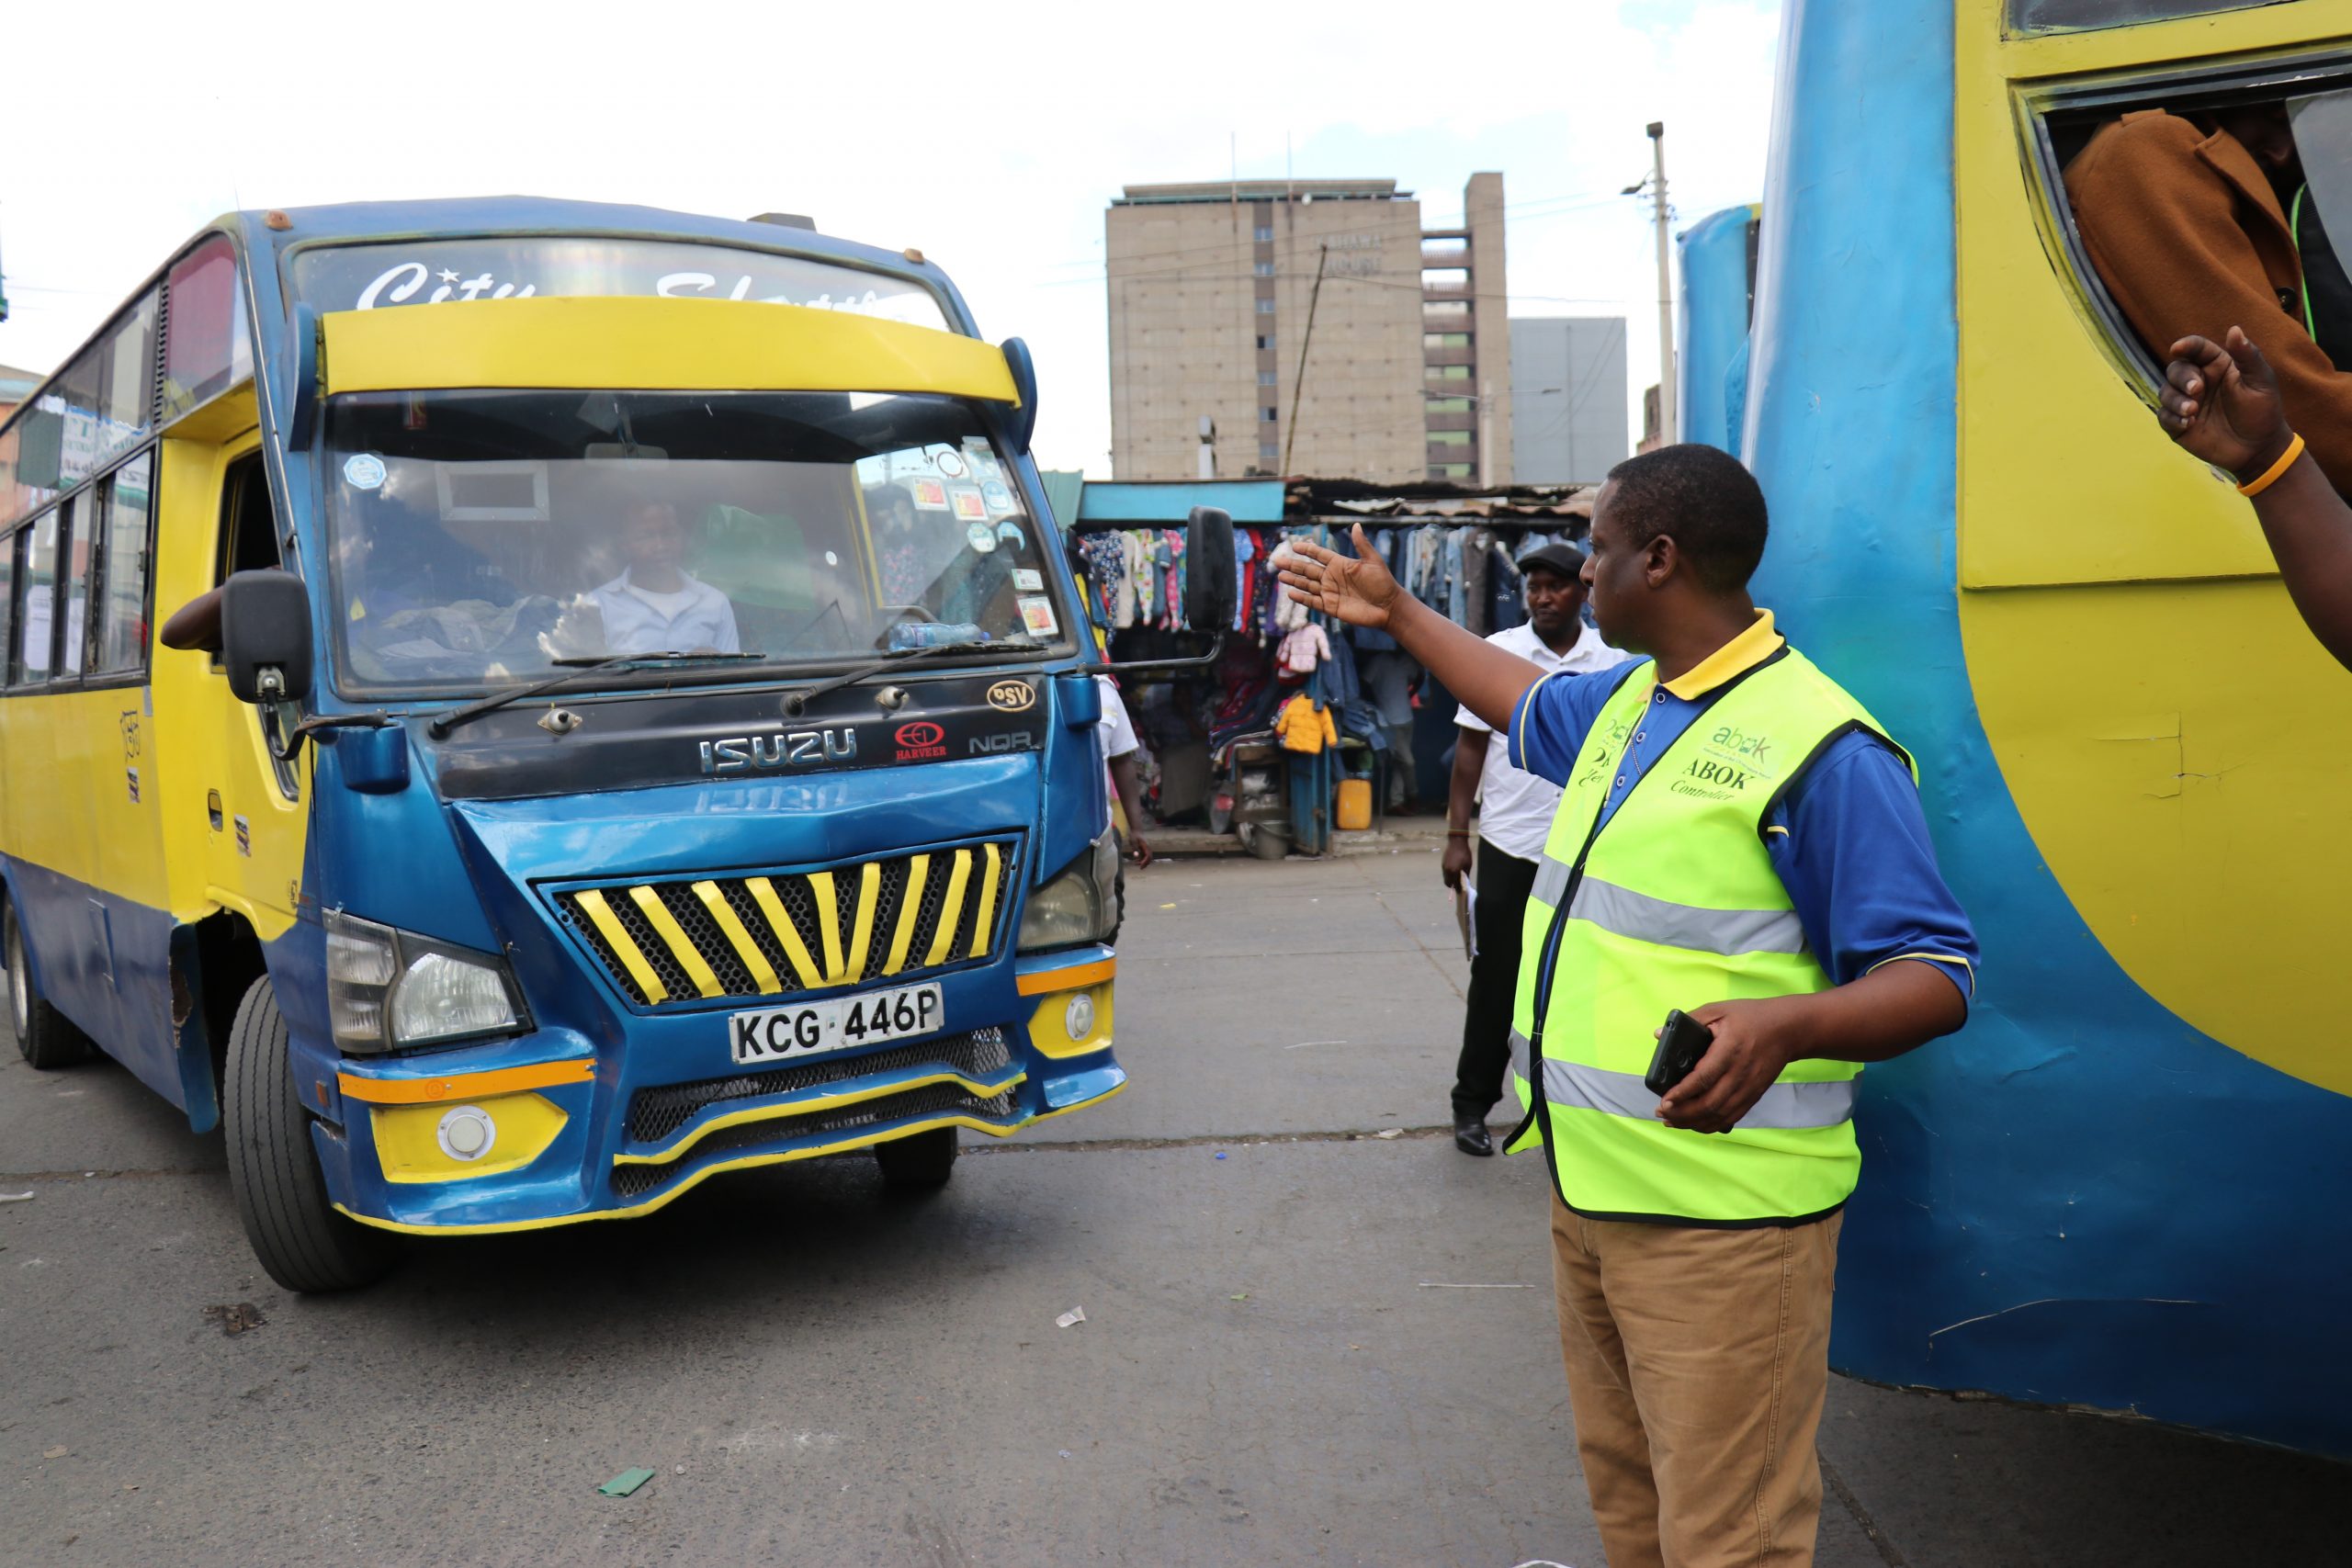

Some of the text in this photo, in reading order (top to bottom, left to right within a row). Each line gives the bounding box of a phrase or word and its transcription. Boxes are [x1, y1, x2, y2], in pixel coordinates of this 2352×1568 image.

[356, 262, 536, 310] Cit
[699, 728, 856, 773] ISUZU
[895, 746, 947, 760] HARVEER
[969, 731, 1031, 754] NQR
[1670, 779, 1736, 801] Controller
[1681, 758, 1756, 790] ABOK
[736, 988, 939, 1058] KCG 446P
